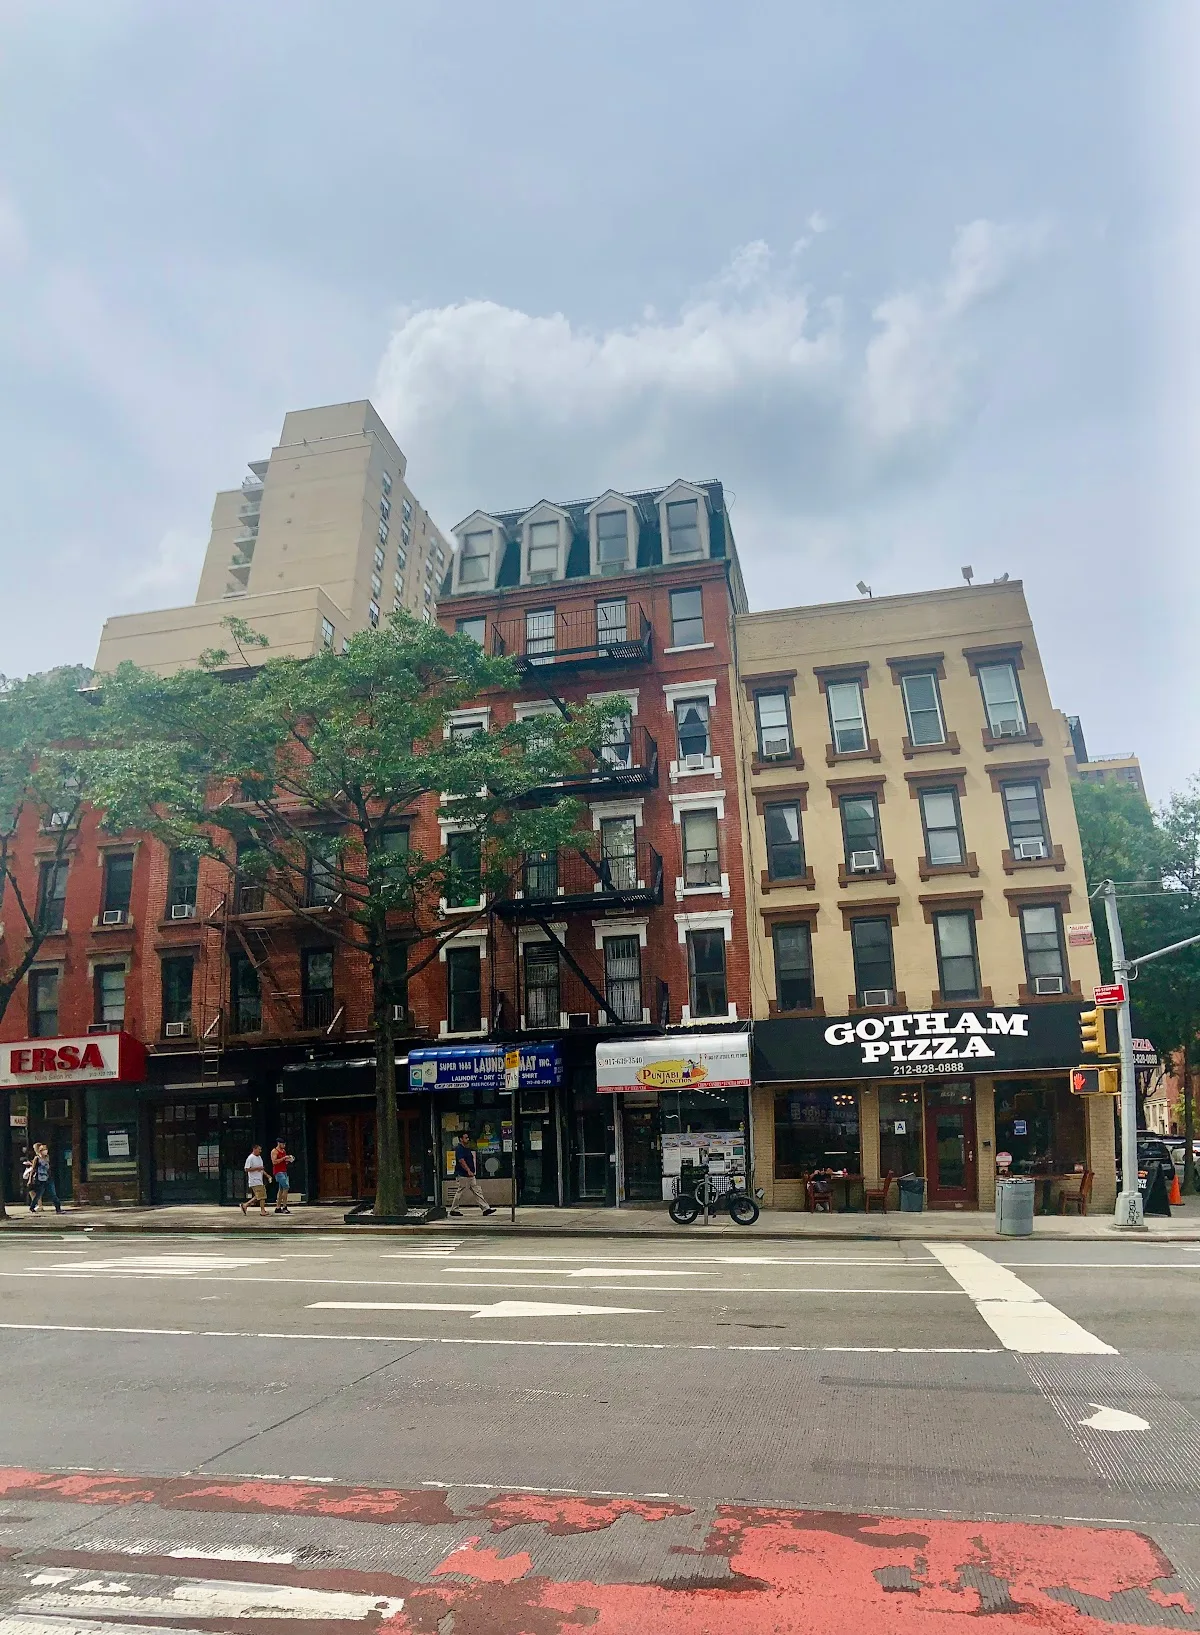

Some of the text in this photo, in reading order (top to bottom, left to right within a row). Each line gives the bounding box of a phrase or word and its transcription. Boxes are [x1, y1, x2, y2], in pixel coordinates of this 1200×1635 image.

[824, 1012, 1029, 1045] GOTHAM
[861, 1036, 995, 1063] PIZZA
[10, 1043, 104, 1073] ERSA
[439, 1062, 457, 1071] SUPER
[893, 1062, 964, 1075] 212-828-0888
[451, 1074, 478, 1082] LAUNDRY
[643, 1069, 679, 1084] PUNJABI
